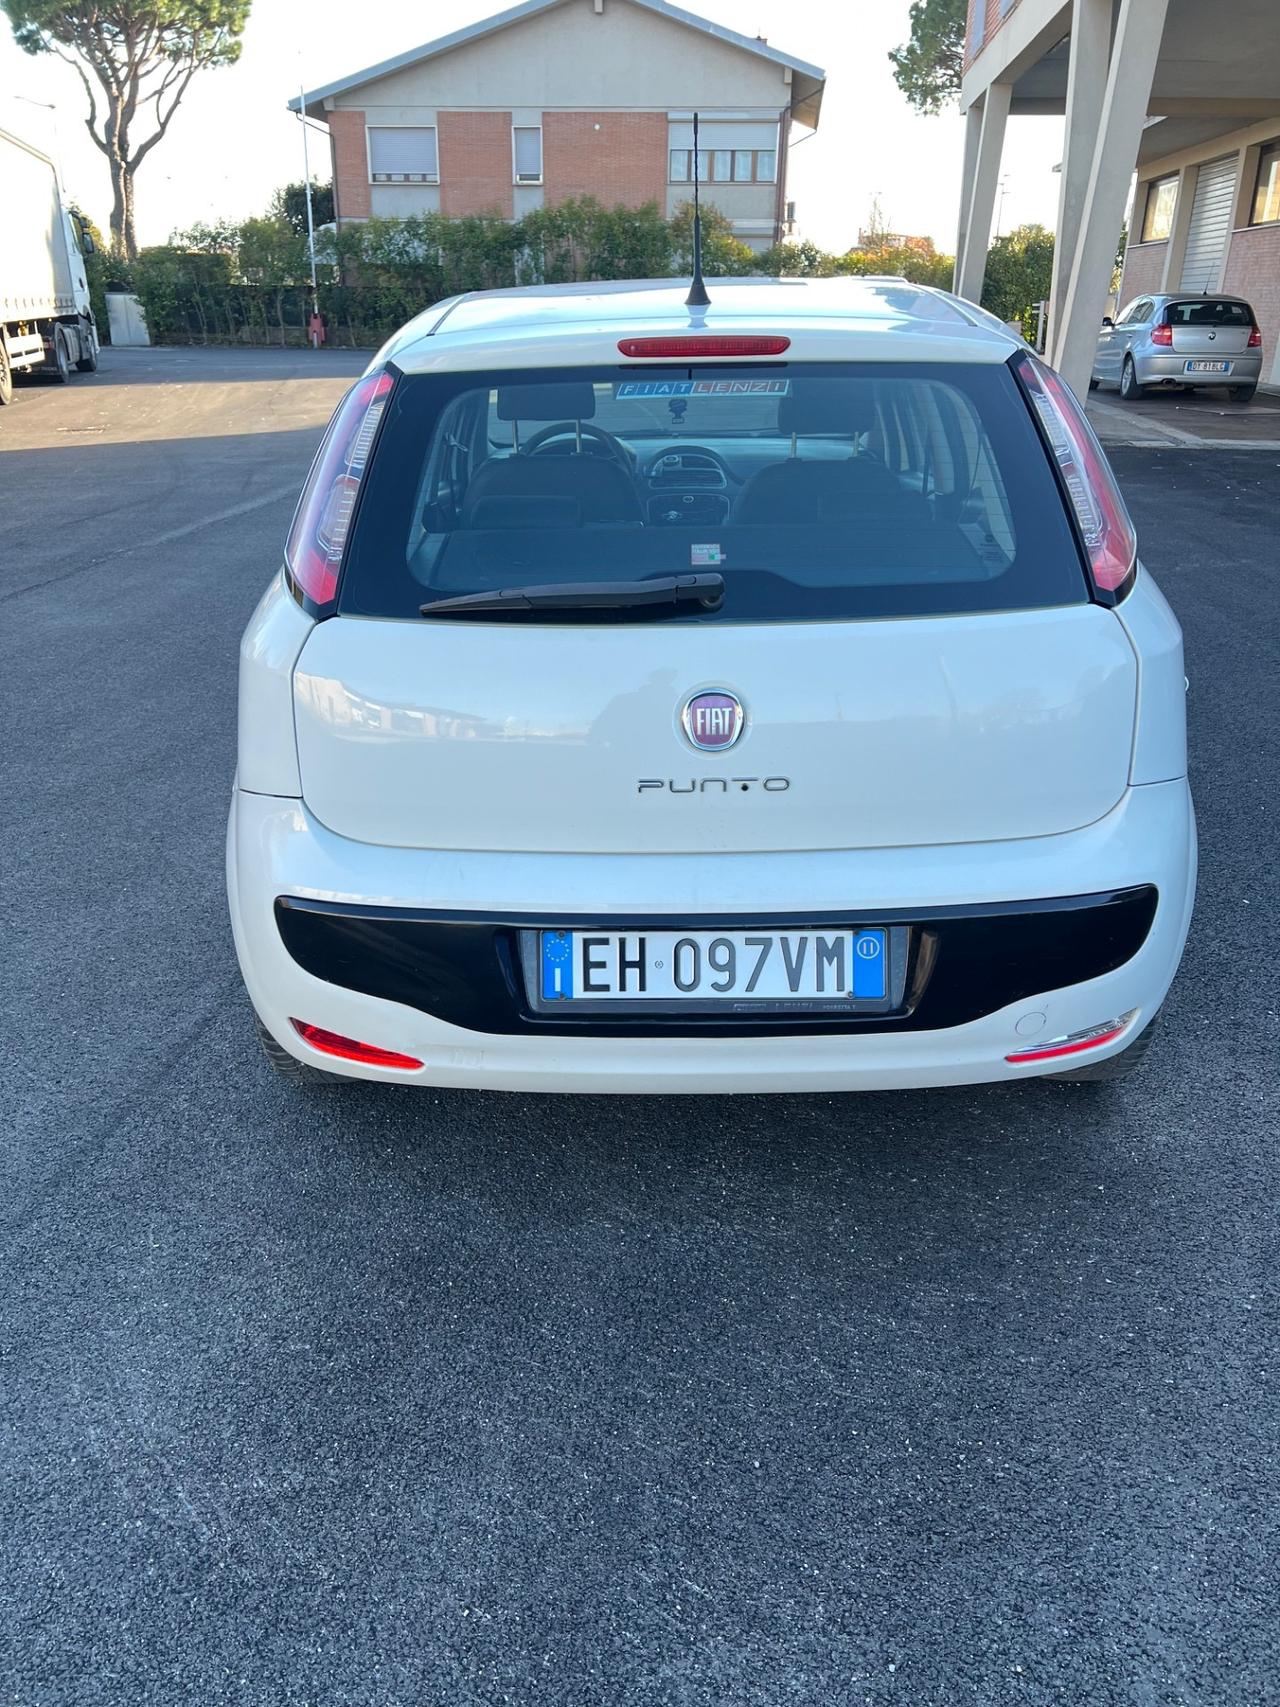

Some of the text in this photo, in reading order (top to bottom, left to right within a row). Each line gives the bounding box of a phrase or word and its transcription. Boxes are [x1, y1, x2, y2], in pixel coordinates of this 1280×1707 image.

[696, 707, 733, 736] FIAT
[638, 776, 790, 794] PUNTO
[582, 937, 647, 993] EH
